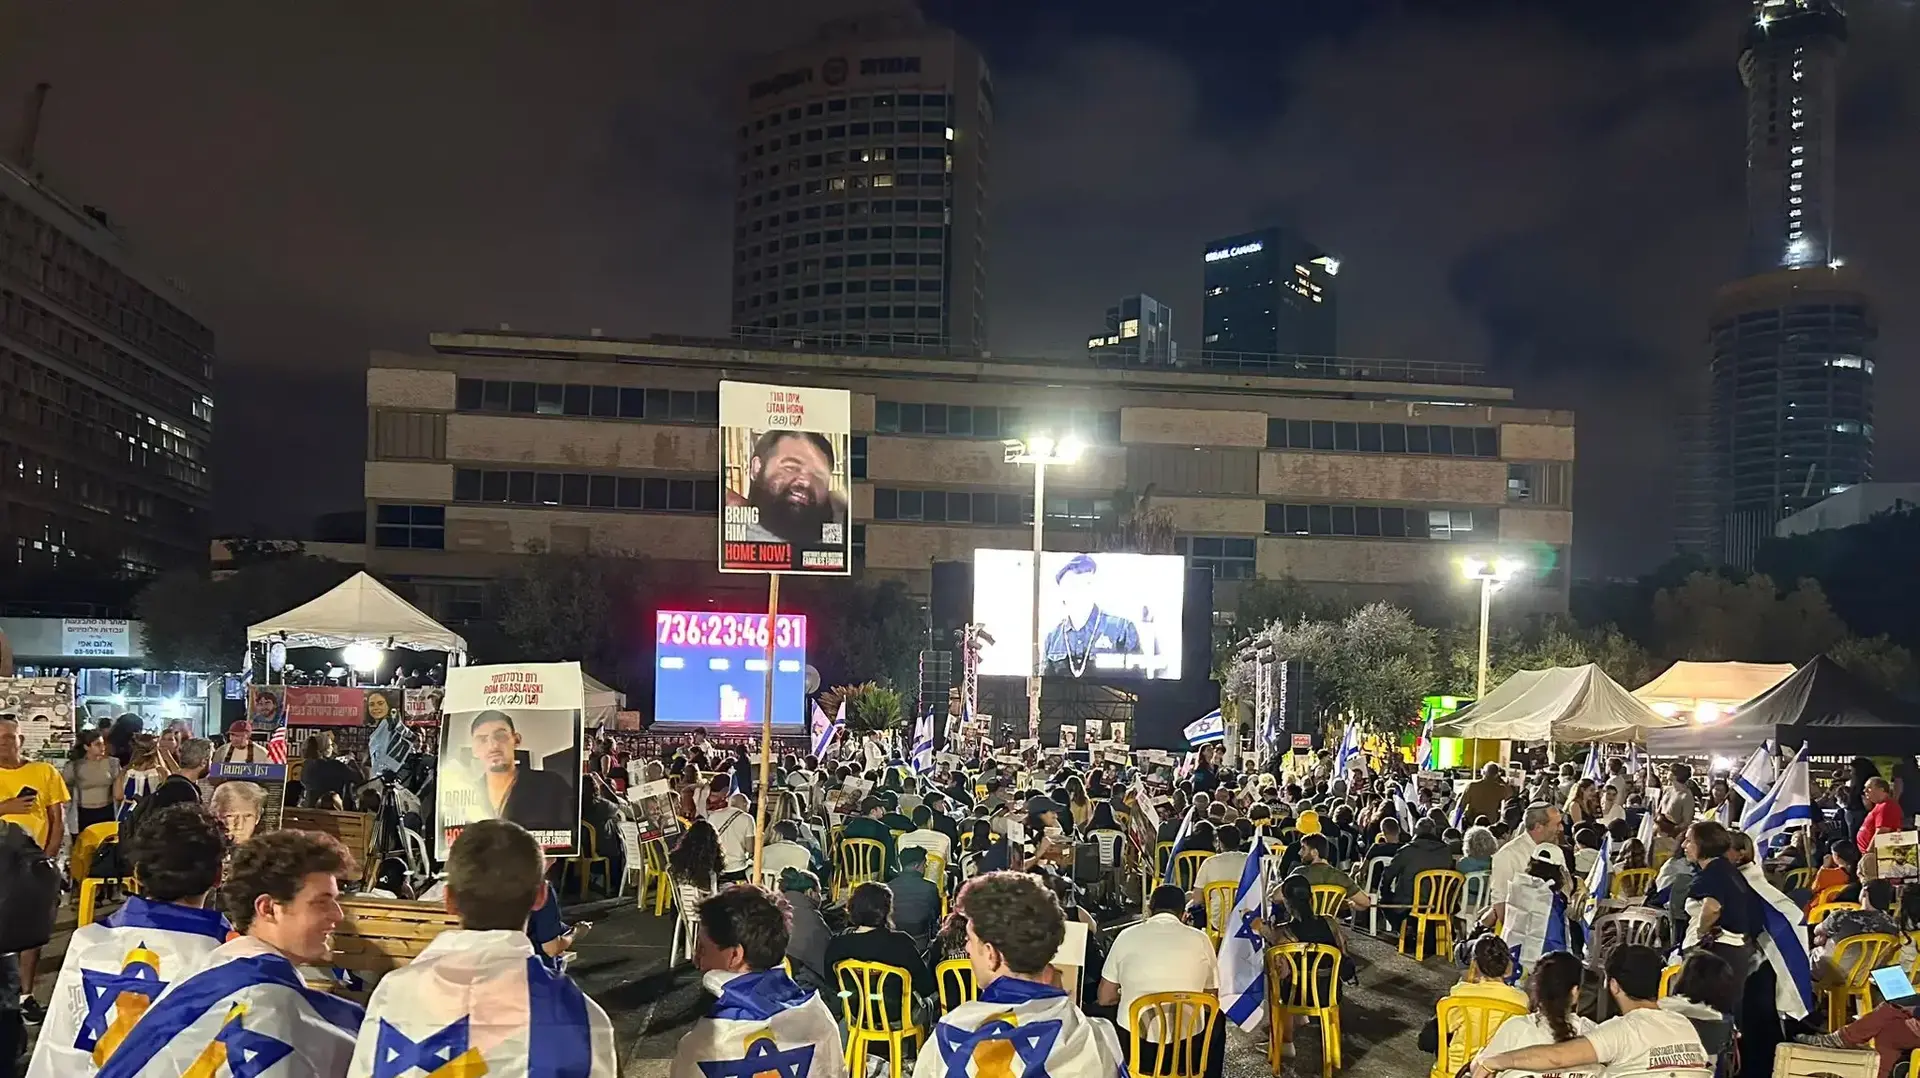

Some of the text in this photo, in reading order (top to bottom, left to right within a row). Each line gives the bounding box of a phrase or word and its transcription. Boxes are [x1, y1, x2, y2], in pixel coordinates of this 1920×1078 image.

[1230, 241, 1263, 257] CANADA
[766, 402, 804, 414] EITAN HORN
[768, 415, 788, 427] (38)
[725, 506, 759, 524] BRING
[725, 523, 747, 541] HIM
[725, 543, 791, 562] HOME NOW!
[657, 613, 801, 648] 736:23:4631
[484, 684, 544, 694] ROM BRASLAVSKI
[220, 763, 269, 777] TRUMP'S LIST
